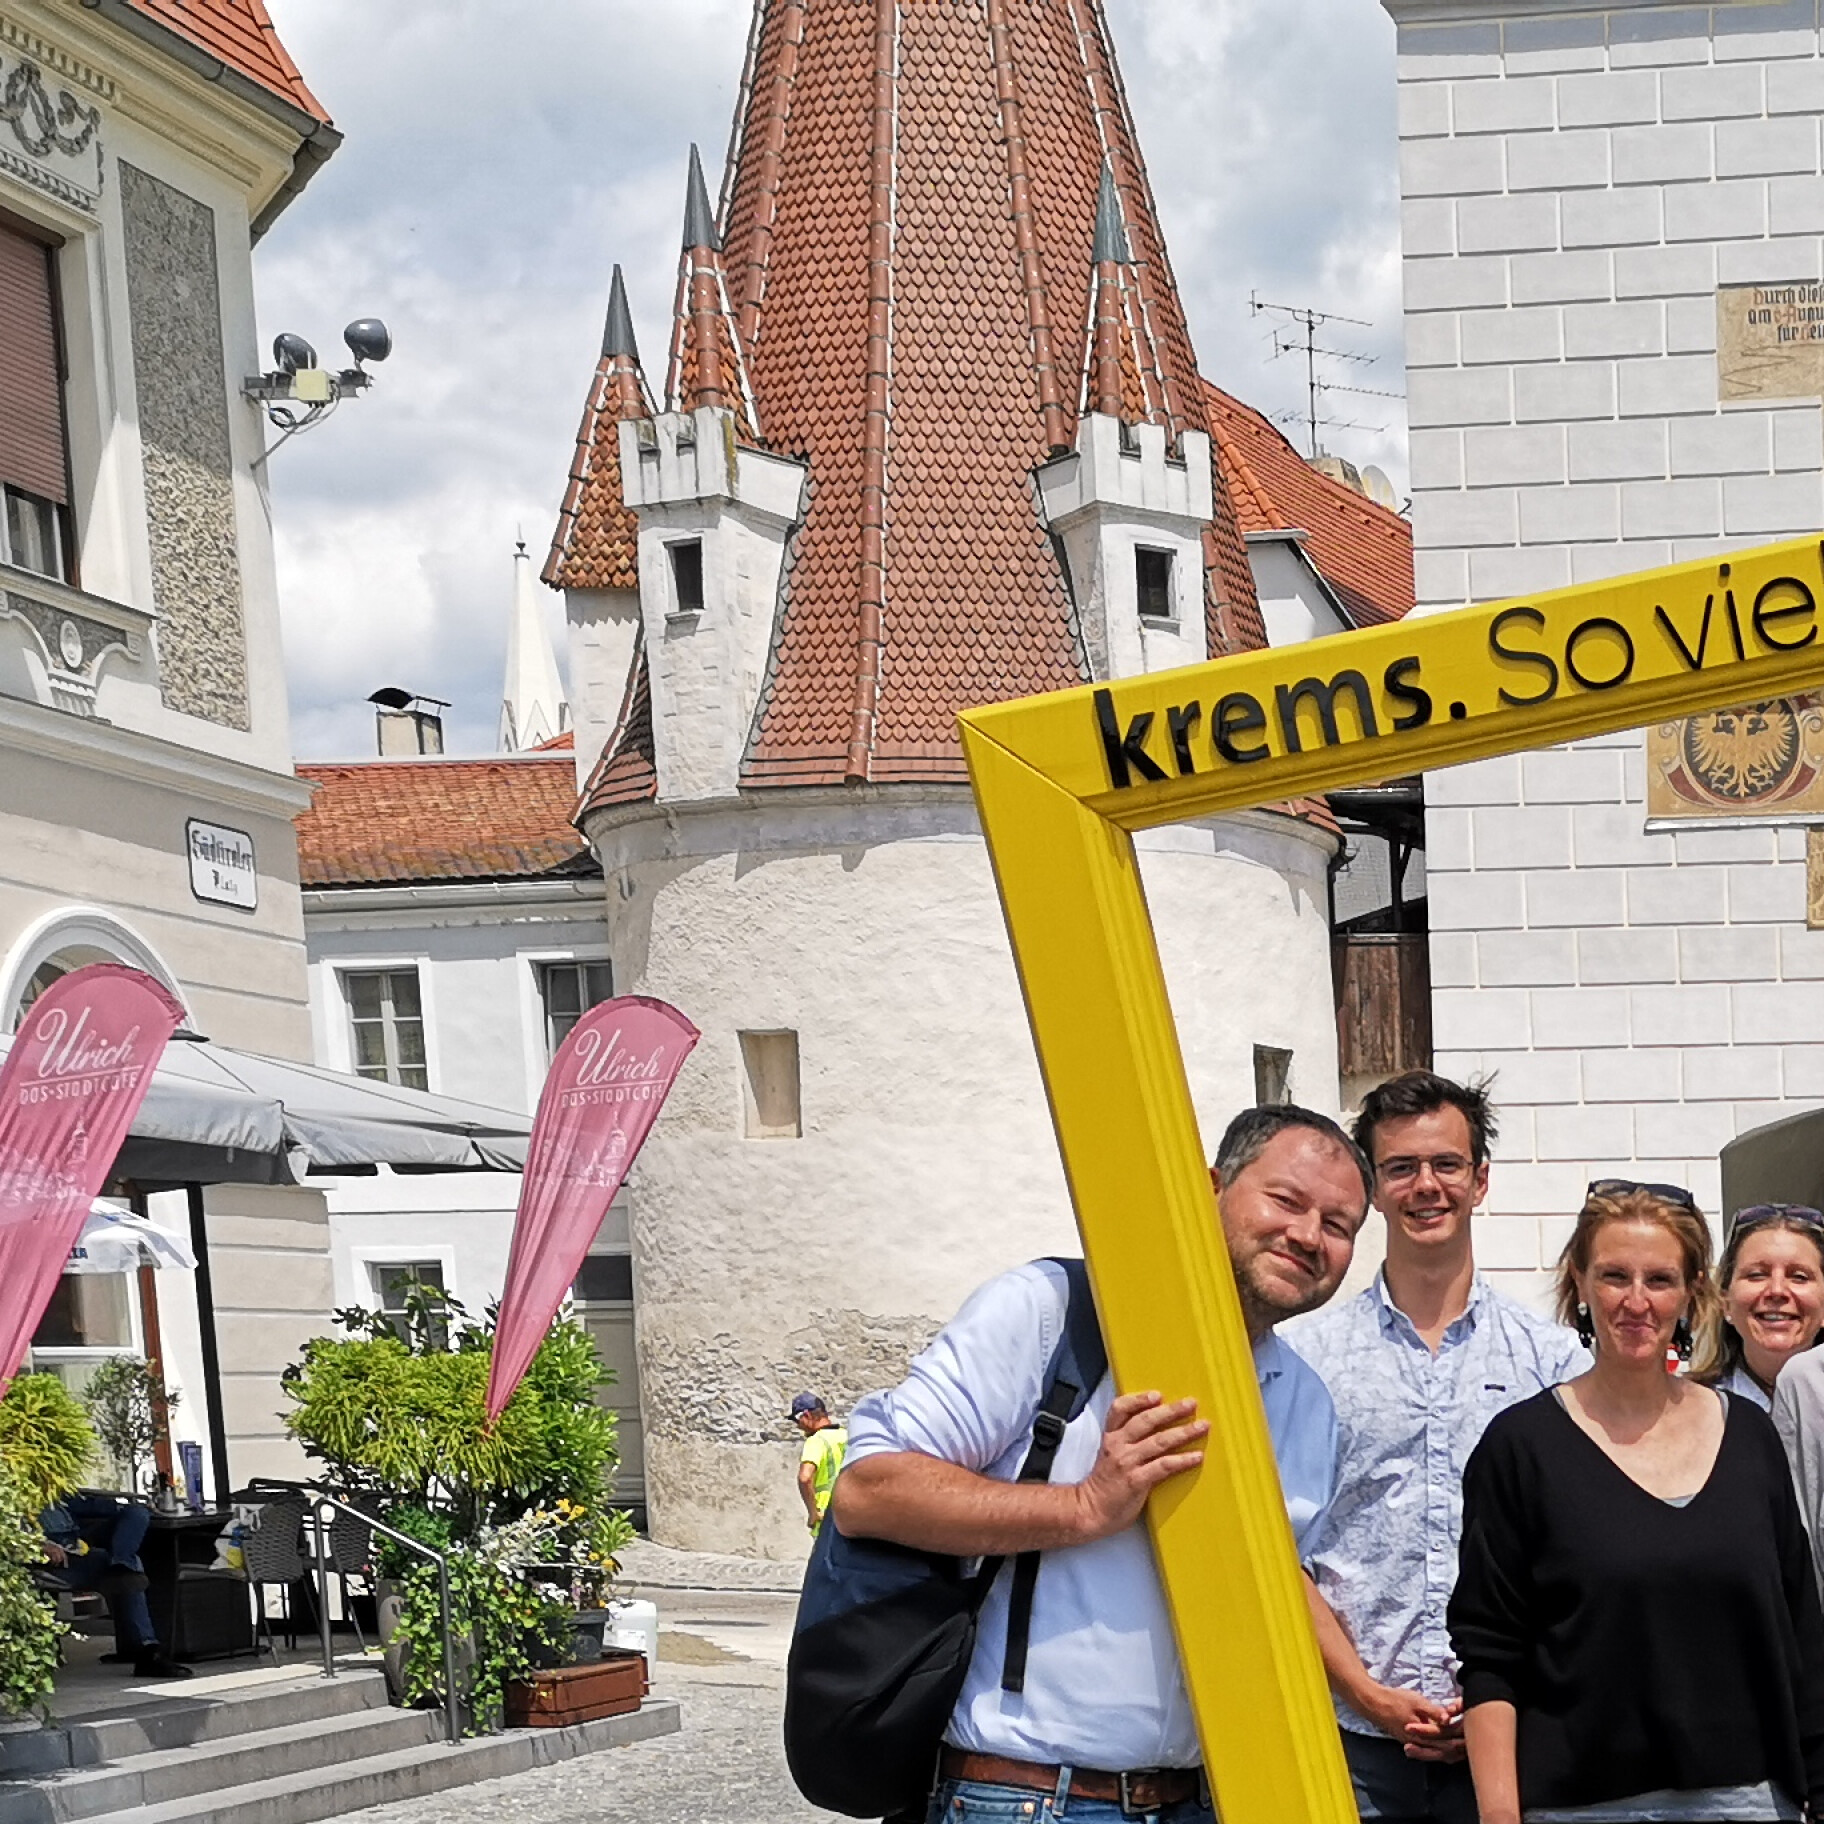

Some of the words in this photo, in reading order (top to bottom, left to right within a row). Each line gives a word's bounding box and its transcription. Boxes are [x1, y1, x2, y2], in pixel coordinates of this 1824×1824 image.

[1753, 286, 1796, 305] Durch
[1748, 308, 1772, 325] am
[1777, 323, 1799, 343] für
[1093, 655, 1467, 790] krems.
[1490, 607, 1635, 708] So
[36, 1006, 141, 1077] Ulrich
[575, 1029, 665, 1086] Ulrich
